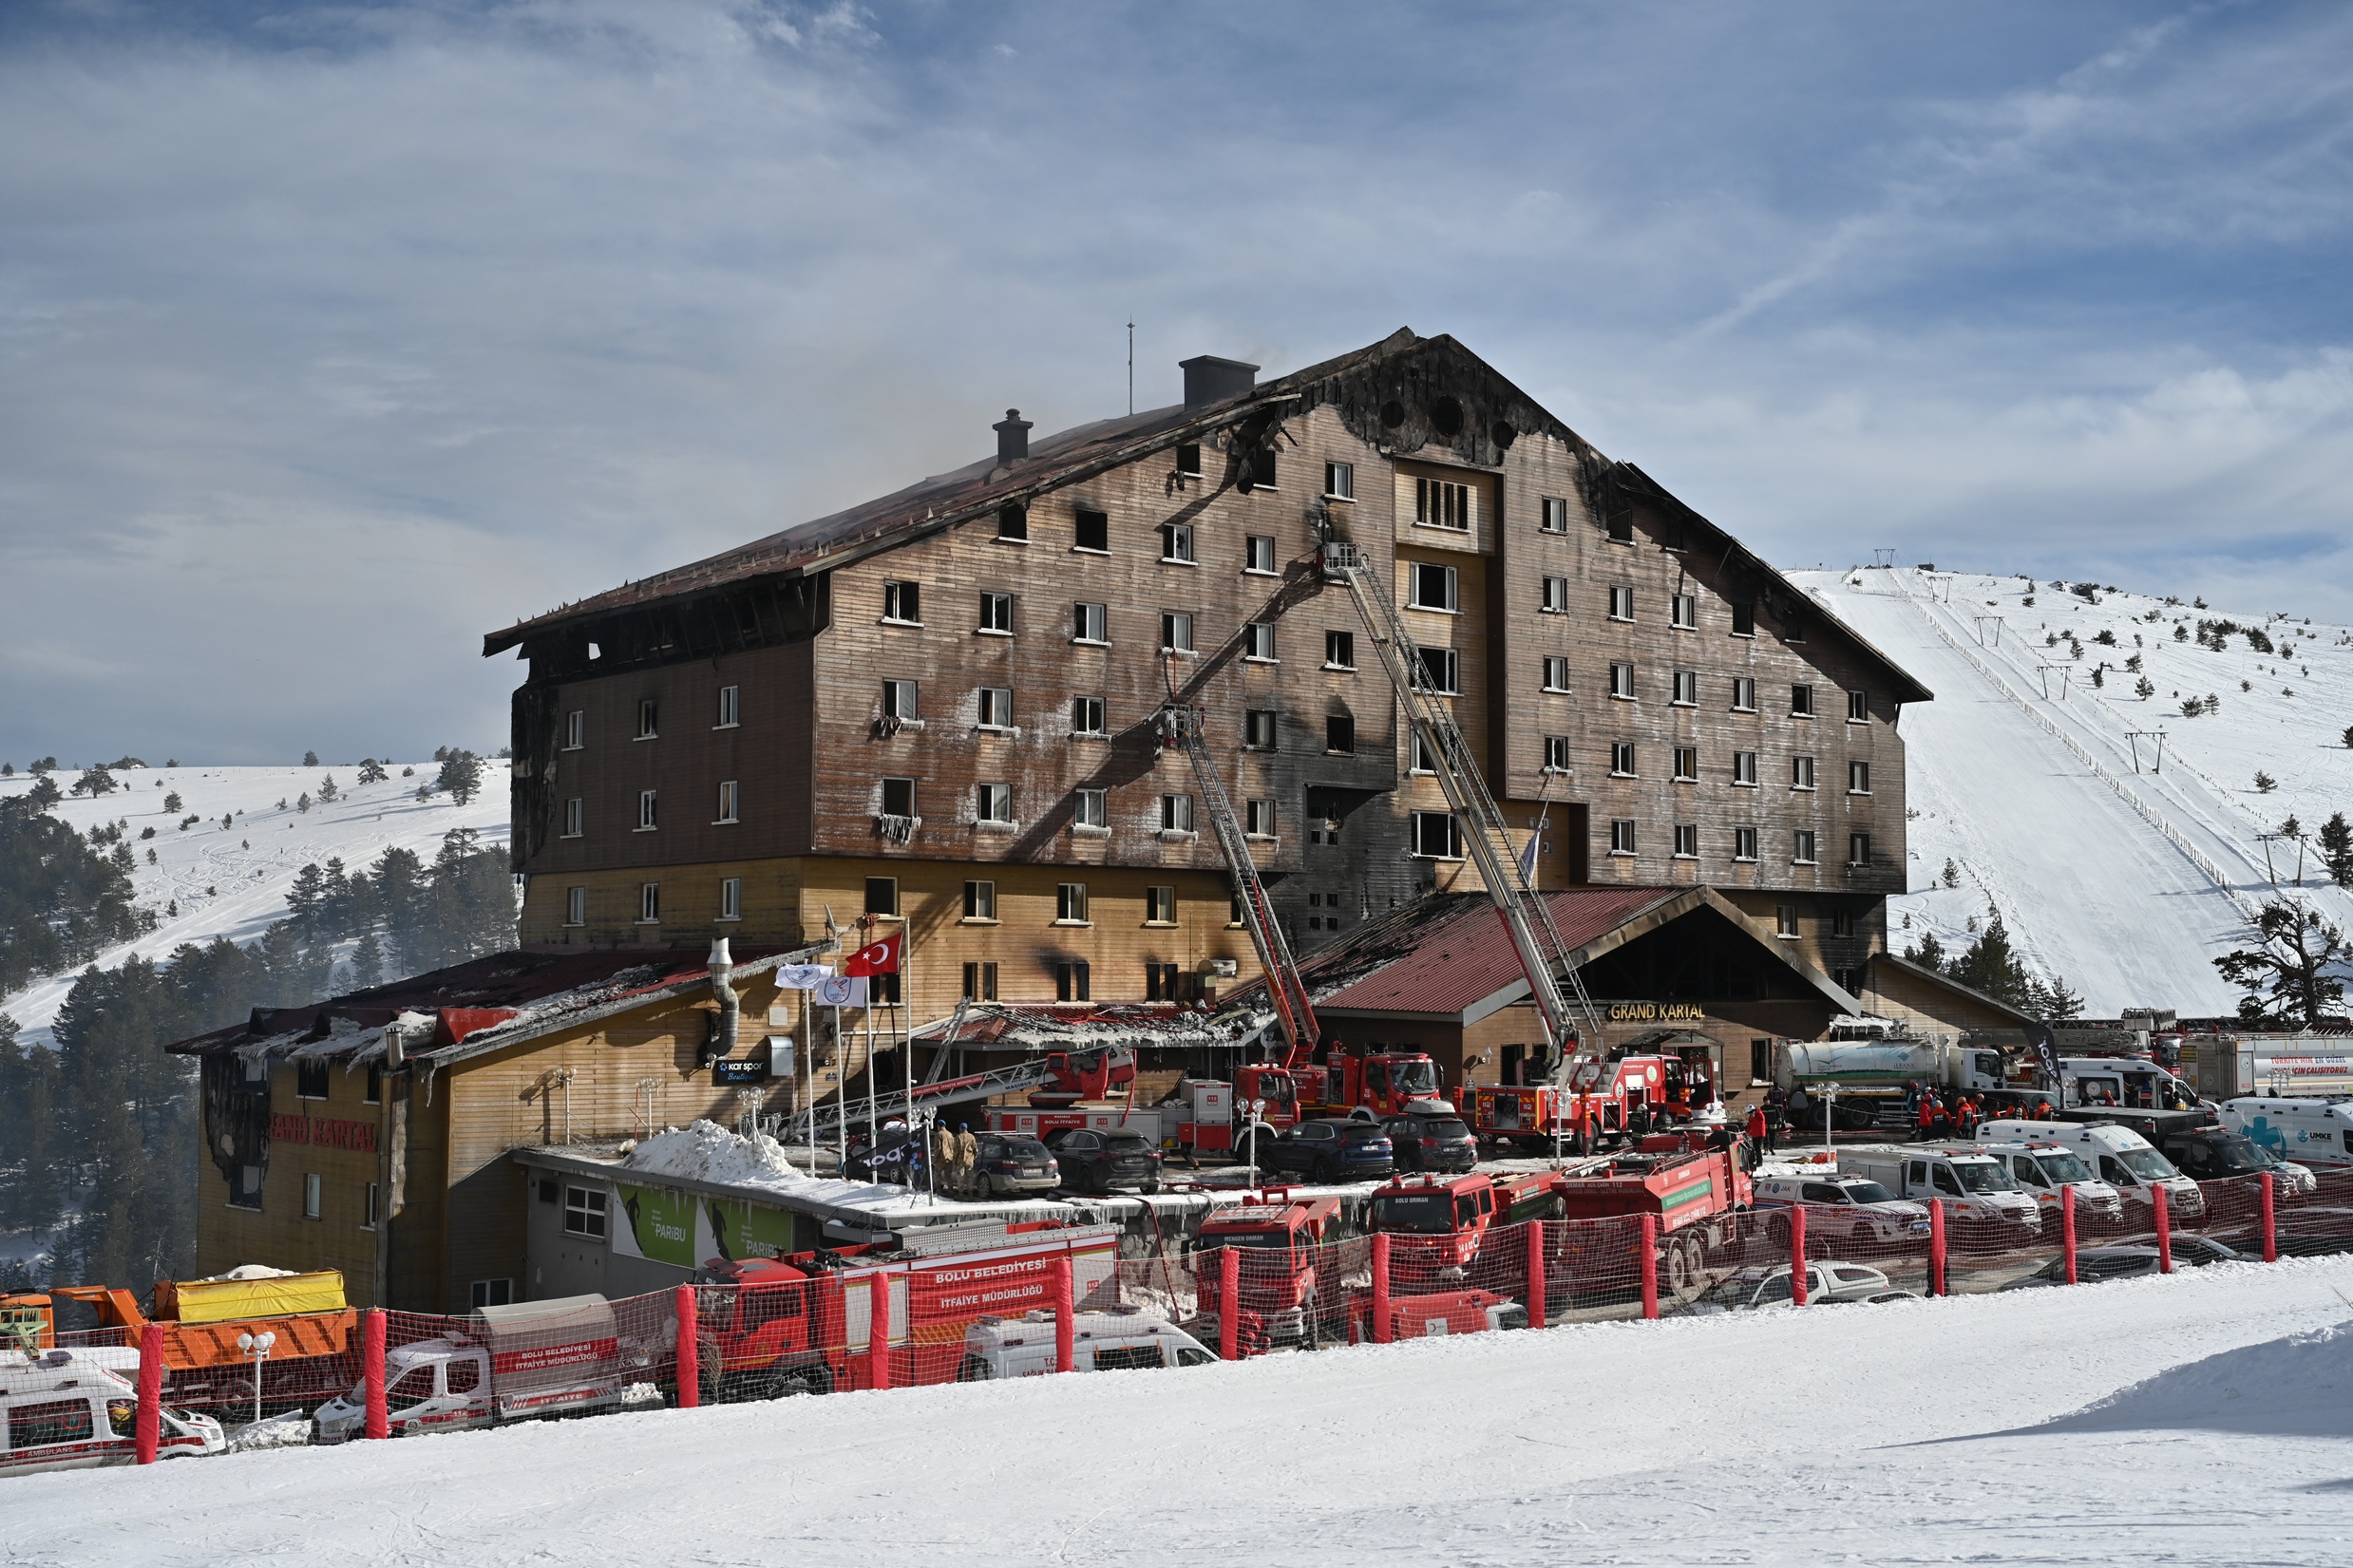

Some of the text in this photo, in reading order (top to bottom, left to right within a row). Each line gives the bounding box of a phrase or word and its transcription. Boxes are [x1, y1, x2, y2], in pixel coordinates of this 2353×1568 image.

[1611, 1004, 1705, 1019] GRAND KARTAL
[2270, 1054, 2346, 1065] TÜRKİYE'NİN EN GÜZEL
[743, 1062, 762, 1072] spor
[2292, 1066, 2306, 1076] İÇİN
[2306, 1066, 2348, 1076] ÇALIŞIYORUZ
[727, 1072, 756, 1083] Boutique
[1005, 1081, 1032, 1091] MAGIRUS
[313, 1117, 377, 1153] KARTAL
[936, 1257, 1046, 1284] BOLU BELEDİYESİ
[941, 1284, 1043, 1309] İTFAİYE MÜDÜRLÜĞÜ
[522, 1343, 591, 1359] BOLU BELEDİYESİ
[516, 1351, 598, 1370] İTFAİYE MÜDÜRLÜĞÜ
[453, 1409, 468, 1418] 112
[27, 1445, 74, 1459] AMBULANS
